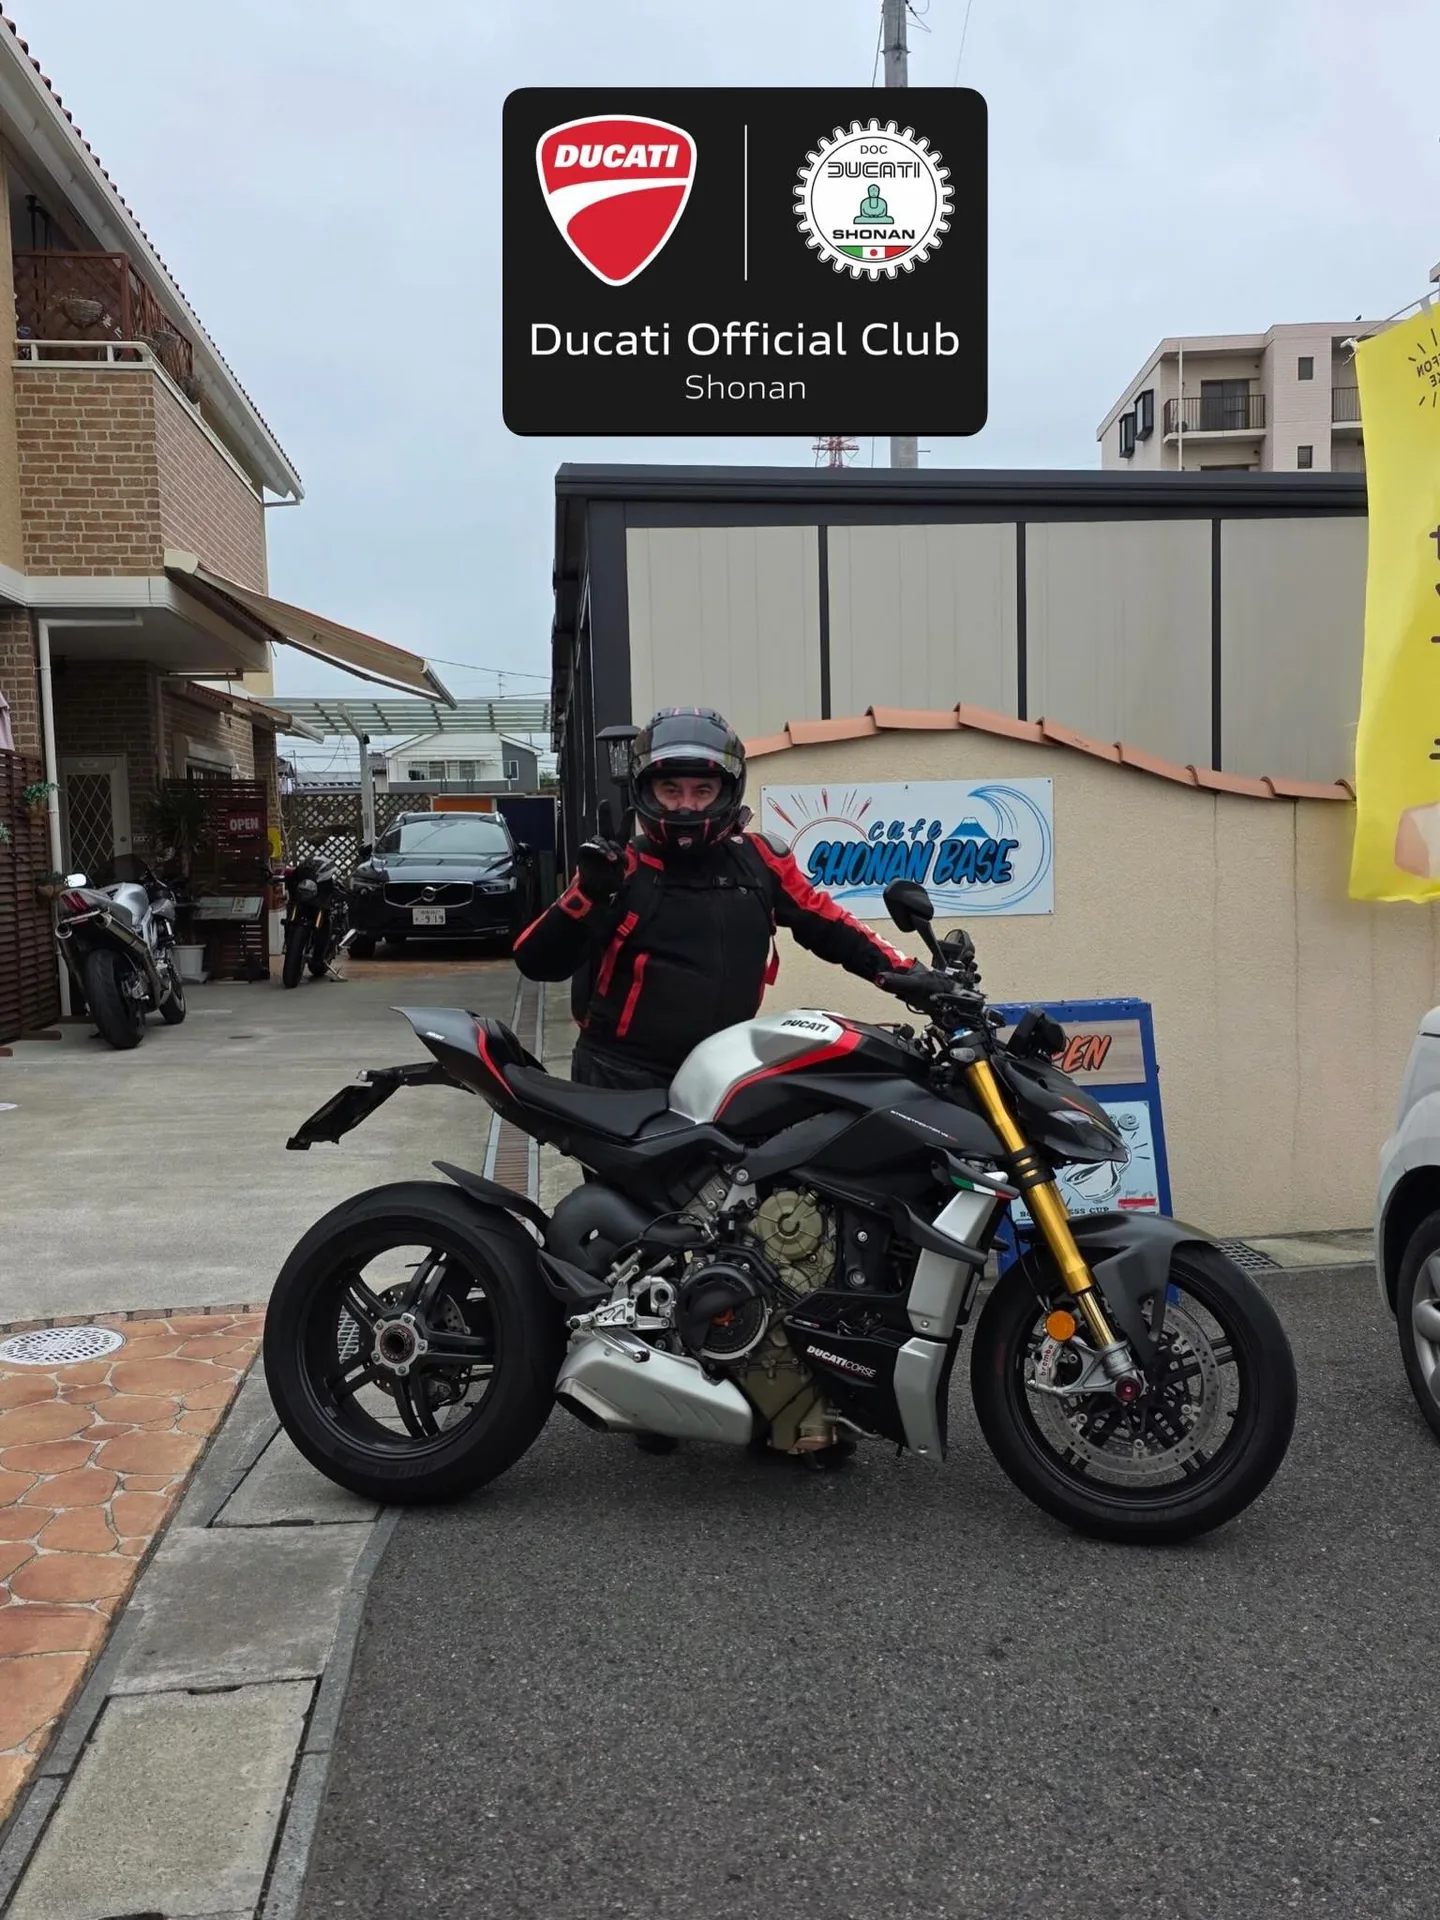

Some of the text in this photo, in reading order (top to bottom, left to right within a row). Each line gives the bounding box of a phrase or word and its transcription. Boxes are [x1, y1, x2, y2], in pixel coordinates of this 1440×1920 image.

[230, 817, 259, 831] OPEN
[868, 818, 943, 842] cafe
[806, 838, 1019, 886] SHONAN BASE
[781, 1019, 830, 1033] DUCATI
[1040, 1344, 1054, 1377] brembo
